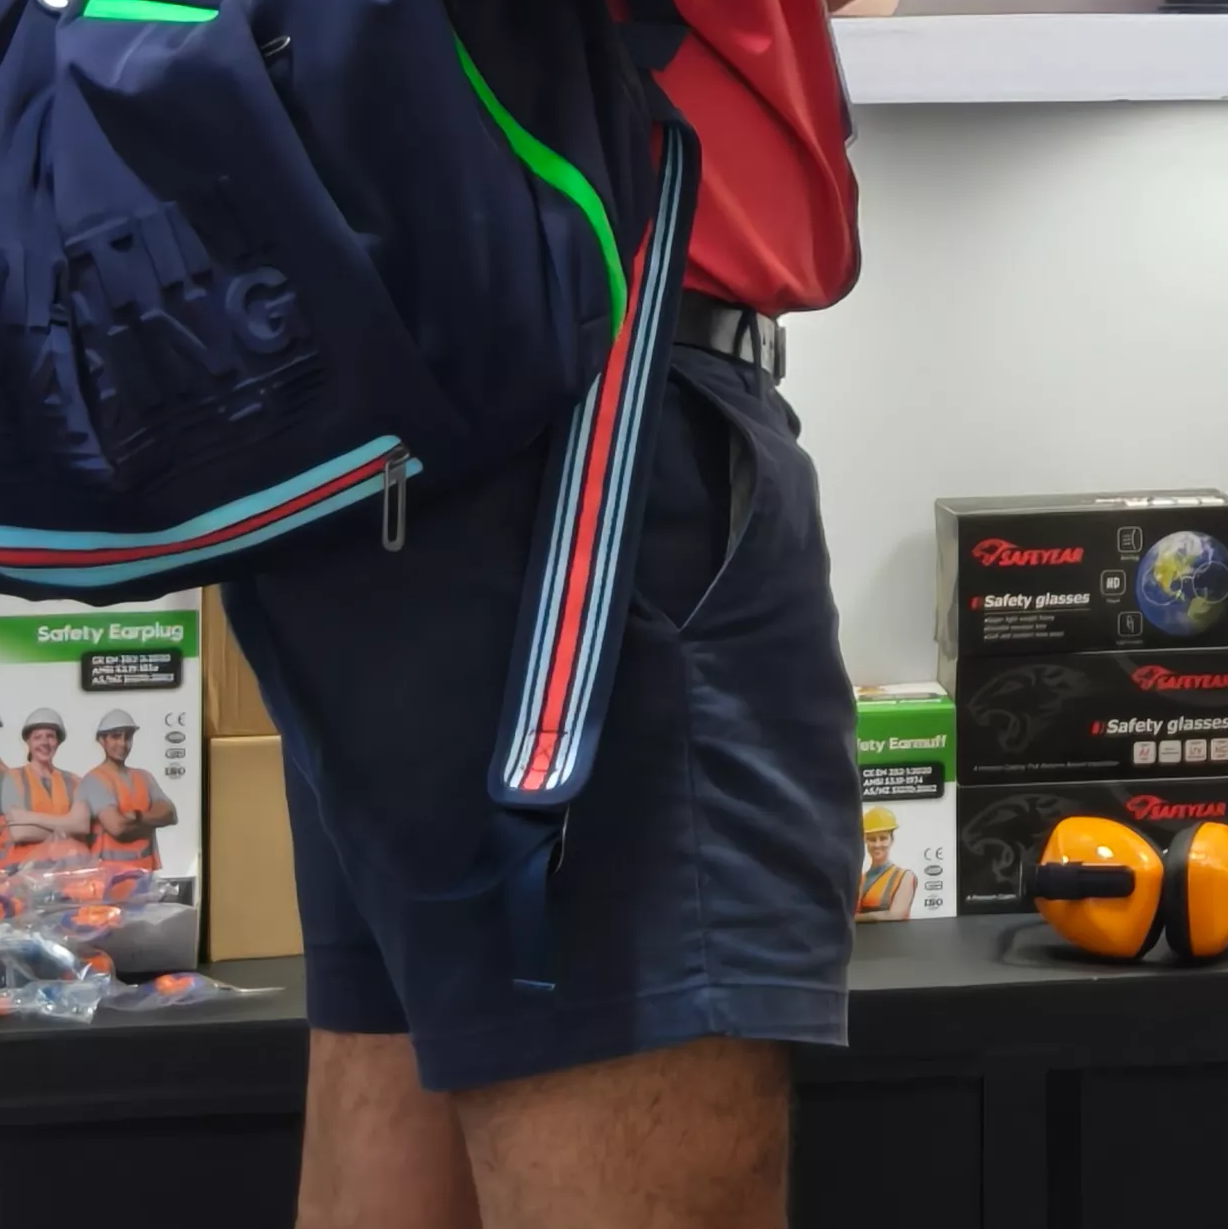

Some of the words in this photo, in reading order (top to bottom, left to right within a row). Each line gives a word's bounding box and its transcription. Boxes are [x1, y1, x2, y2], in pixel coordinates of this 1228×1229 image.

[998, 547, 1084, 566] SAFEYEAR
[984, 593, 1032, 610] Safety
[1035, 592, 1091, 609] glasses
[37, 624, 105, 644] Safety
[109, 622, 184, 642] Earplug
[1106, 718, 1163, 736] Safety
[889, 734, 947, 749] Earmuff
